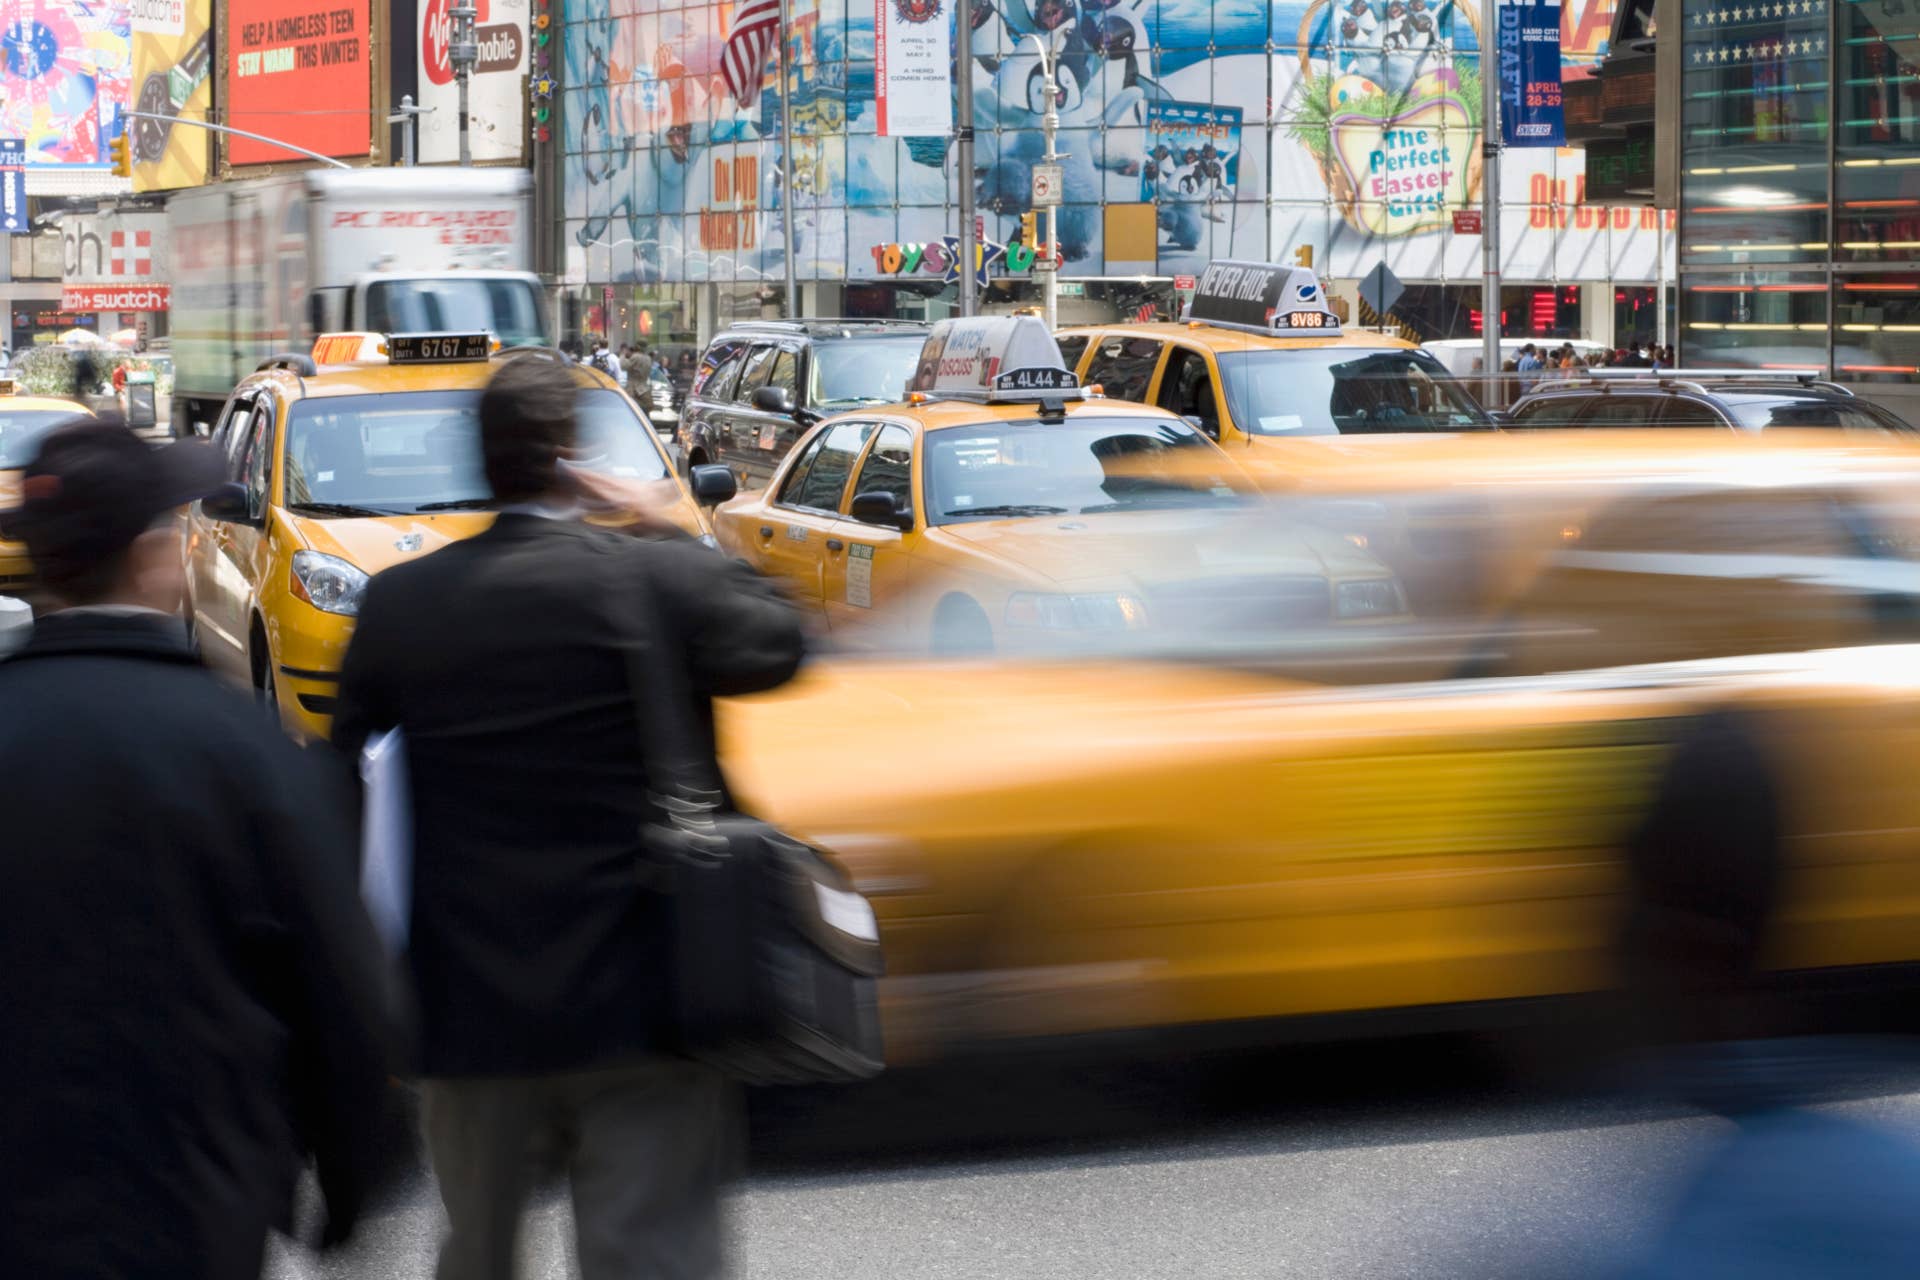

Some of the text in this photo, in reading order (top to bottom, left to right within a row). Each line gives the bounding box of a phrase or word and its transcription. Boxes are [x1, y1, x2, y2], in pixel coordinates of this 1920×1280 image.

[242, 8, 354, 47] HELP A HOMELESS TEEN
[238, 37, 360, 77] STAY WARM THIS WINTER
[1501, 9, 1521, 106] DRAFT
[1527, 82, 1561, 93] APRIL
[1527, 95, 1561, 106] 28-29
[1383, 129, 1428, 149] The
[1369, 147, 1451, 174] Perfect
[1371, 170, 1454, 197] Easter
[1530, 173, 1567, 229] ON
[871, 243, 946, 273] TOYS
[1197, 265, 1275, 303] NEVER HIDE
[93, 290, 161, 308] swatch
[1291, 312, 1322, 327] 8V86
[395, 350, 413, 358] DUTY
[421, 339, 461, 357] 6767
[466, 347, 485, 356] DUTY
[1017, 371, 1054, 387] 4L44
